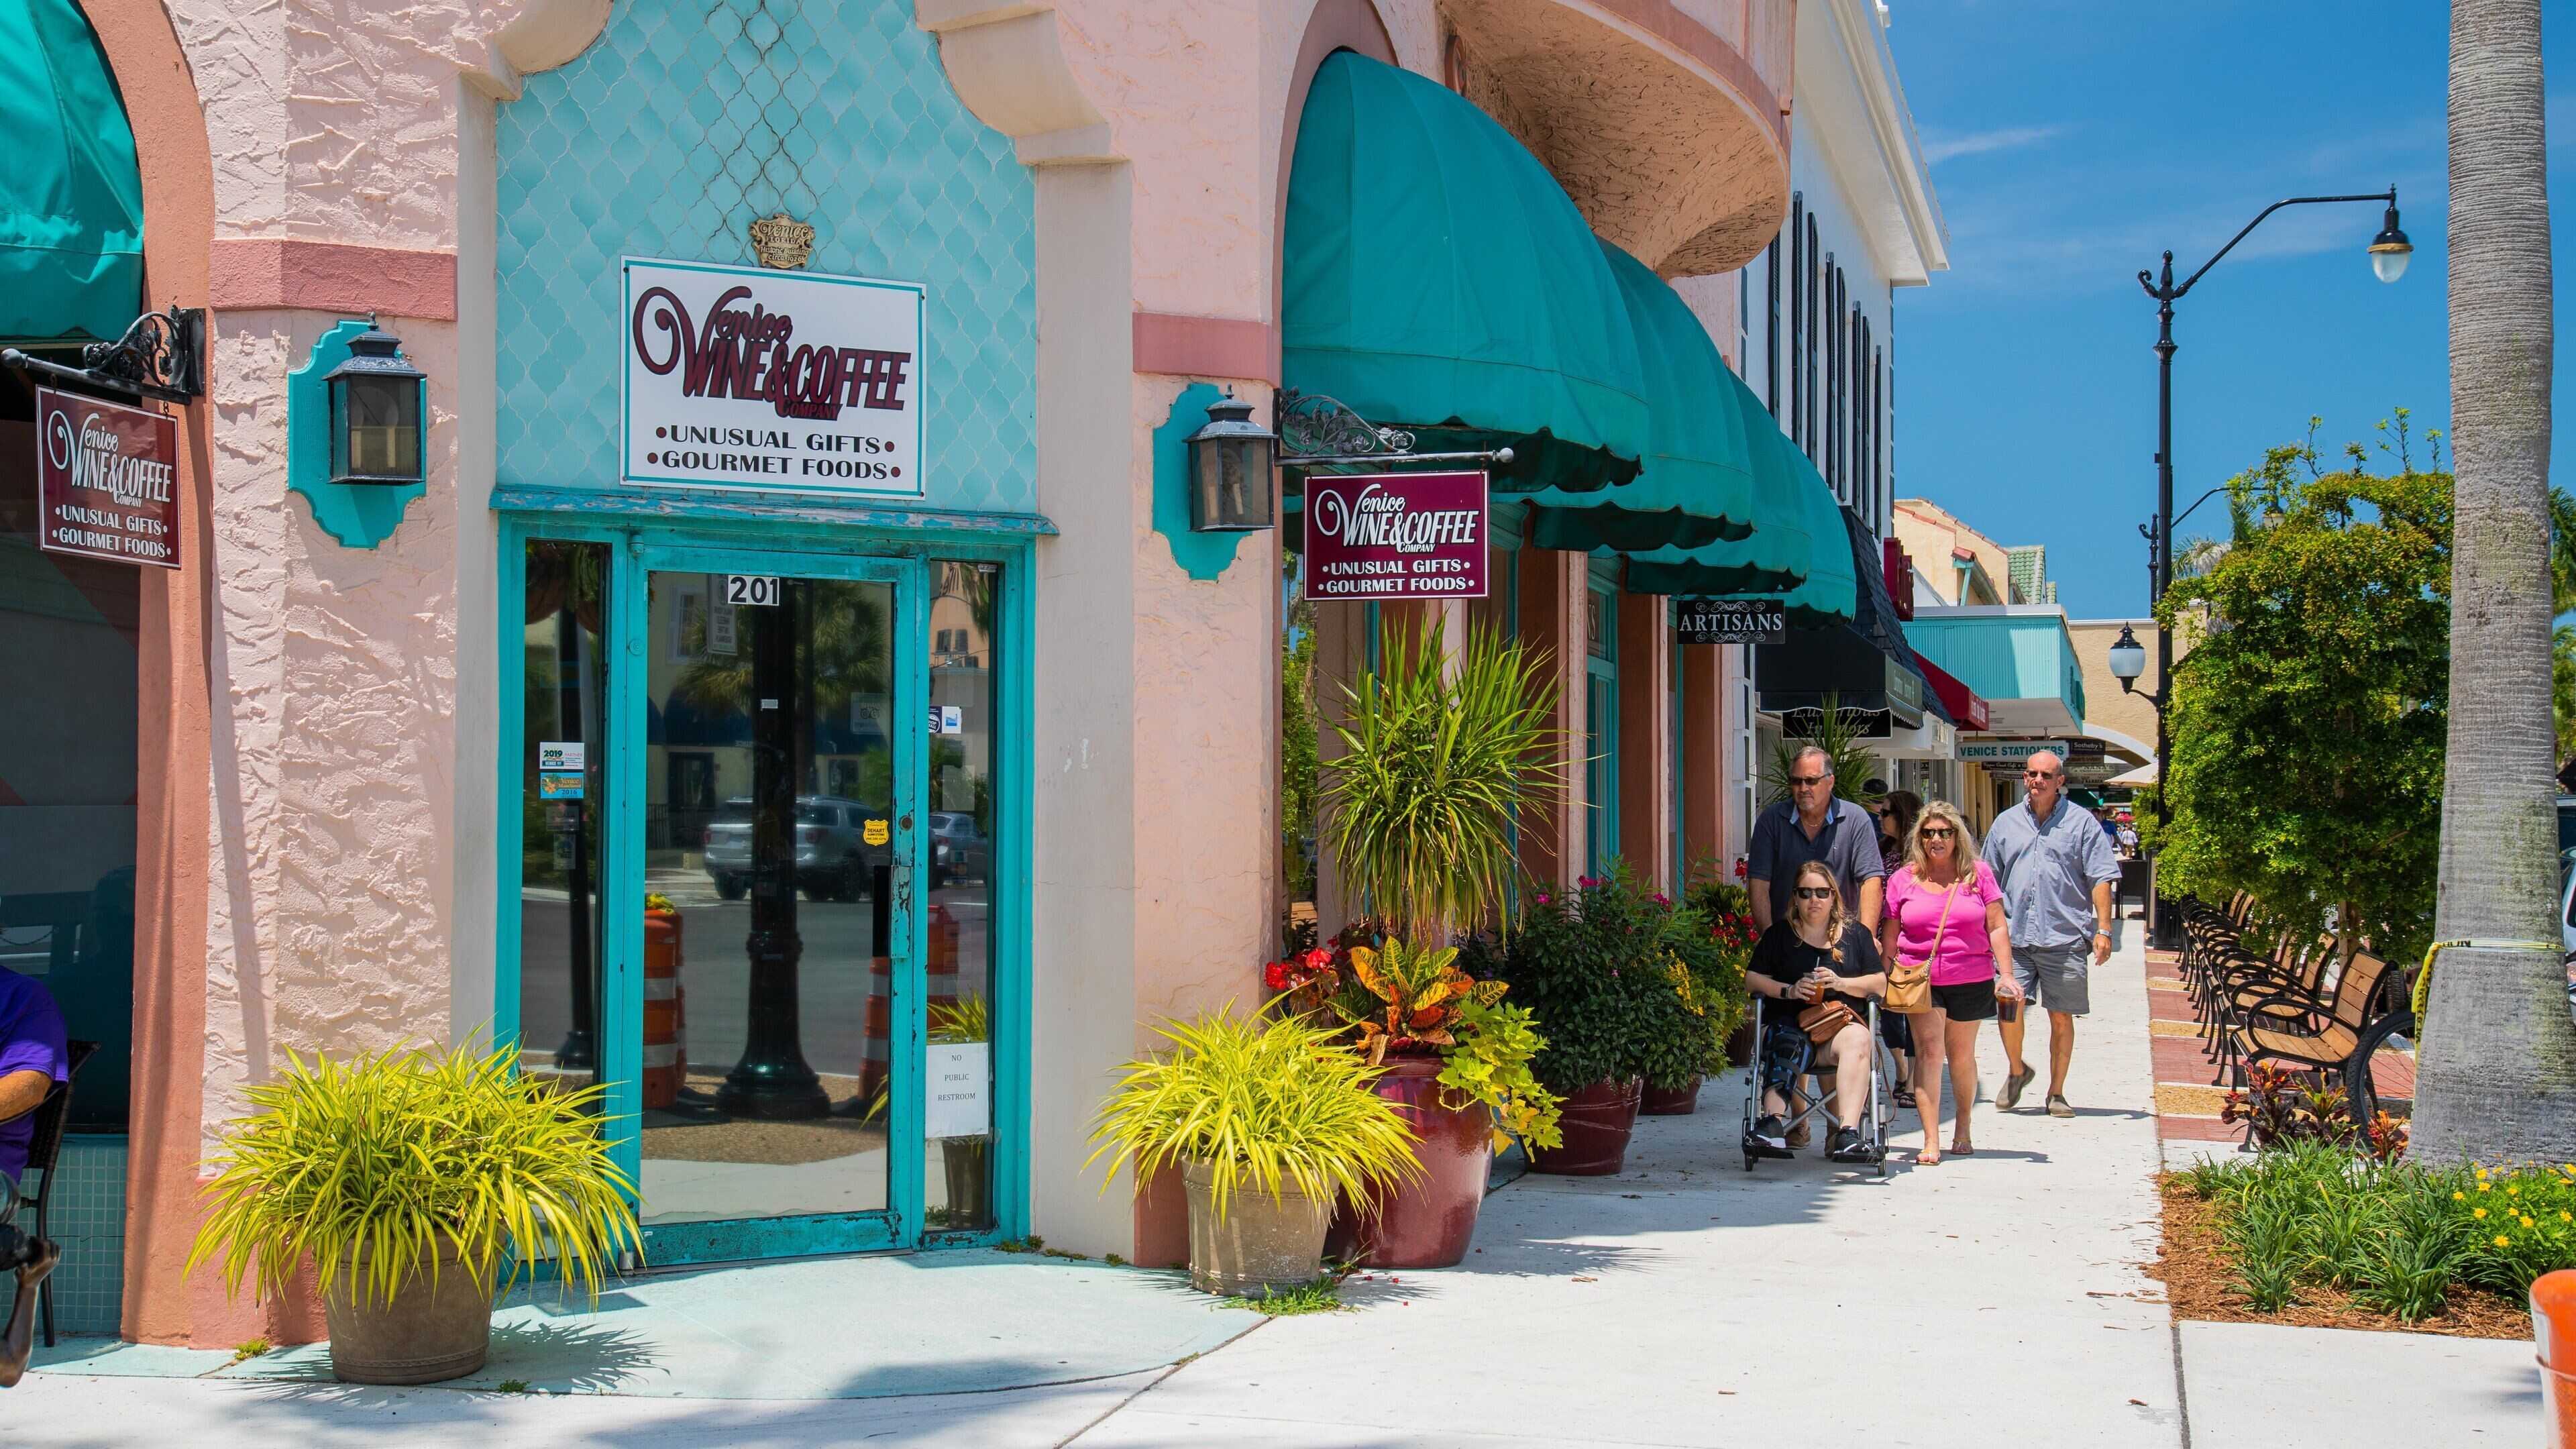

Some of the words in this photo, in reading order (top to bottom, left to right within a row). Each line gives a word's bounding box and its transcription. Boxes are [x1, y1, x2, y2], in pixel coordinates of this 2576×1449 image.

[759, 222, 808, 239] Venice
[766, 236, 802, 244] FLORIDA
[783, 247, 809, 258] Building
[633, 286, 793, 376] Venice
[671, 425, 796, 450] UNUSUAL
[806, 433, 881, 454] GIFTS
[661, 450, 792, 474] GOURMET
[802, 458, 888, 480] FOODS
[1315, 483, 1405, 535] Venice
[62, 504, 122, 529] UNUSUAL
[126, 515, 162, 535] GIFTS
[59, 527, 121, 551] GOURMET
[125, 537, 165, 558] FOODS
[1330, 560, 1408, 575] UNUSUAL
[1412, 559, 1461, 574] GIFTS
[730, 576, 778, 604] 201
[1326, 578, 1405, 593] GOURMET
[1410, 577, 1466, 591] FOODS
[1679, 613, 1782, 632] ARTISANS
[1960, 747, 1998, 756] VENICE
[945, 1073, 969, 1081] PUBLIC
[938, 1093, 975, 1101] RESTROOM
